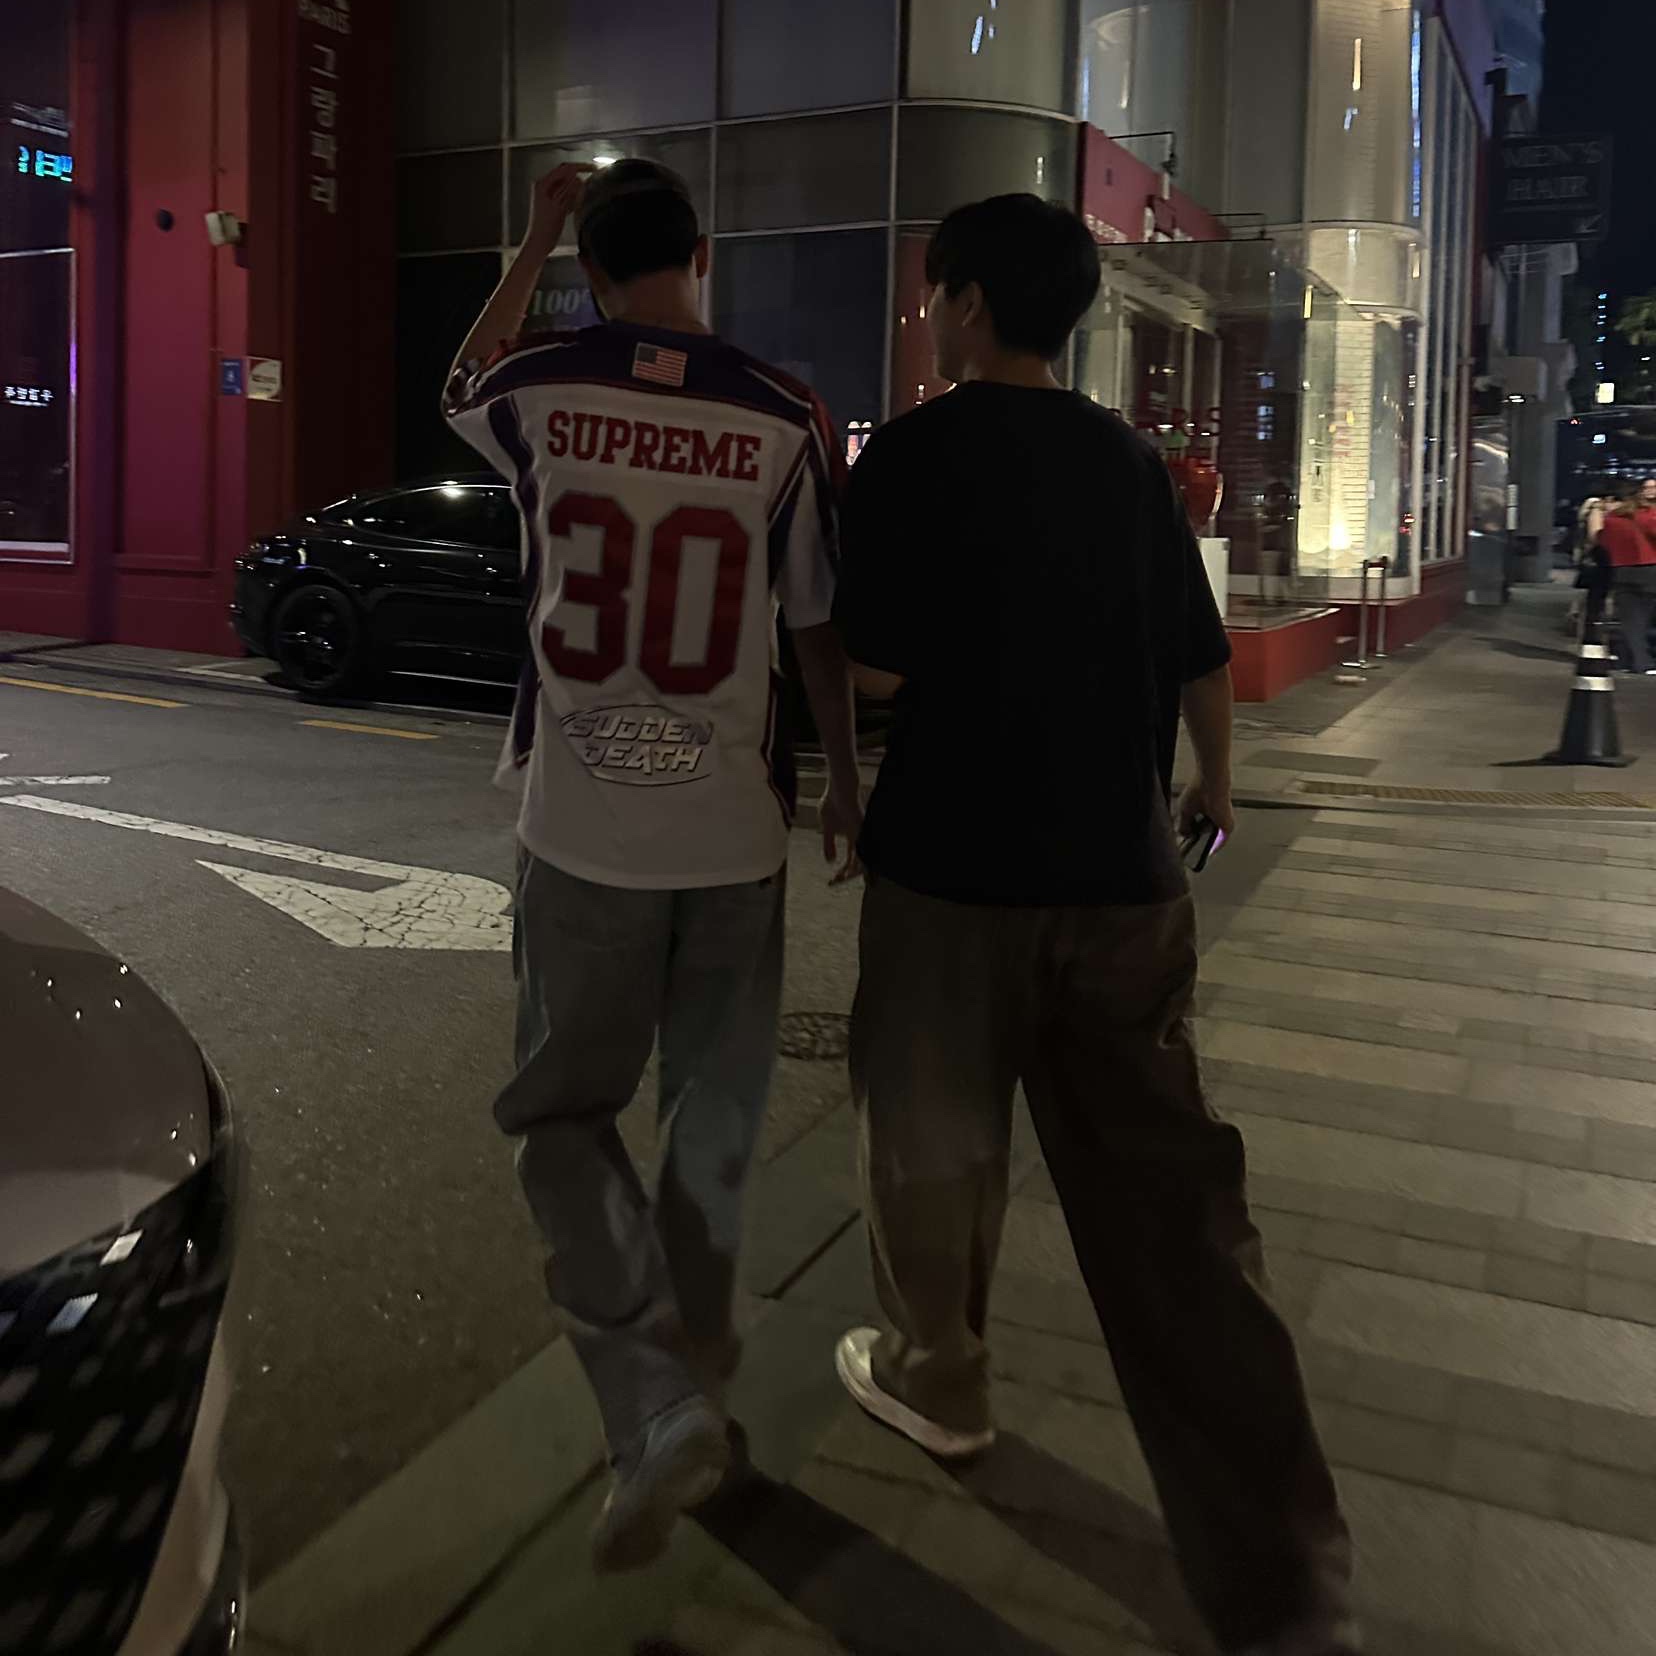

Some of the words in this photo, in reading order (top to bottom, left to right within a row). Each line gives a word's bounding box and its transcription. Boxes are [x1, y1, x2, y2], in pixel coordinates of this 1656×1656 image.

[547, 410, 761, 482] SUPREME
[542, 489, 750, 694] 30
[568, 714, 714, 746] SUDDEN
[582, 743, 704, 776] DEATH
